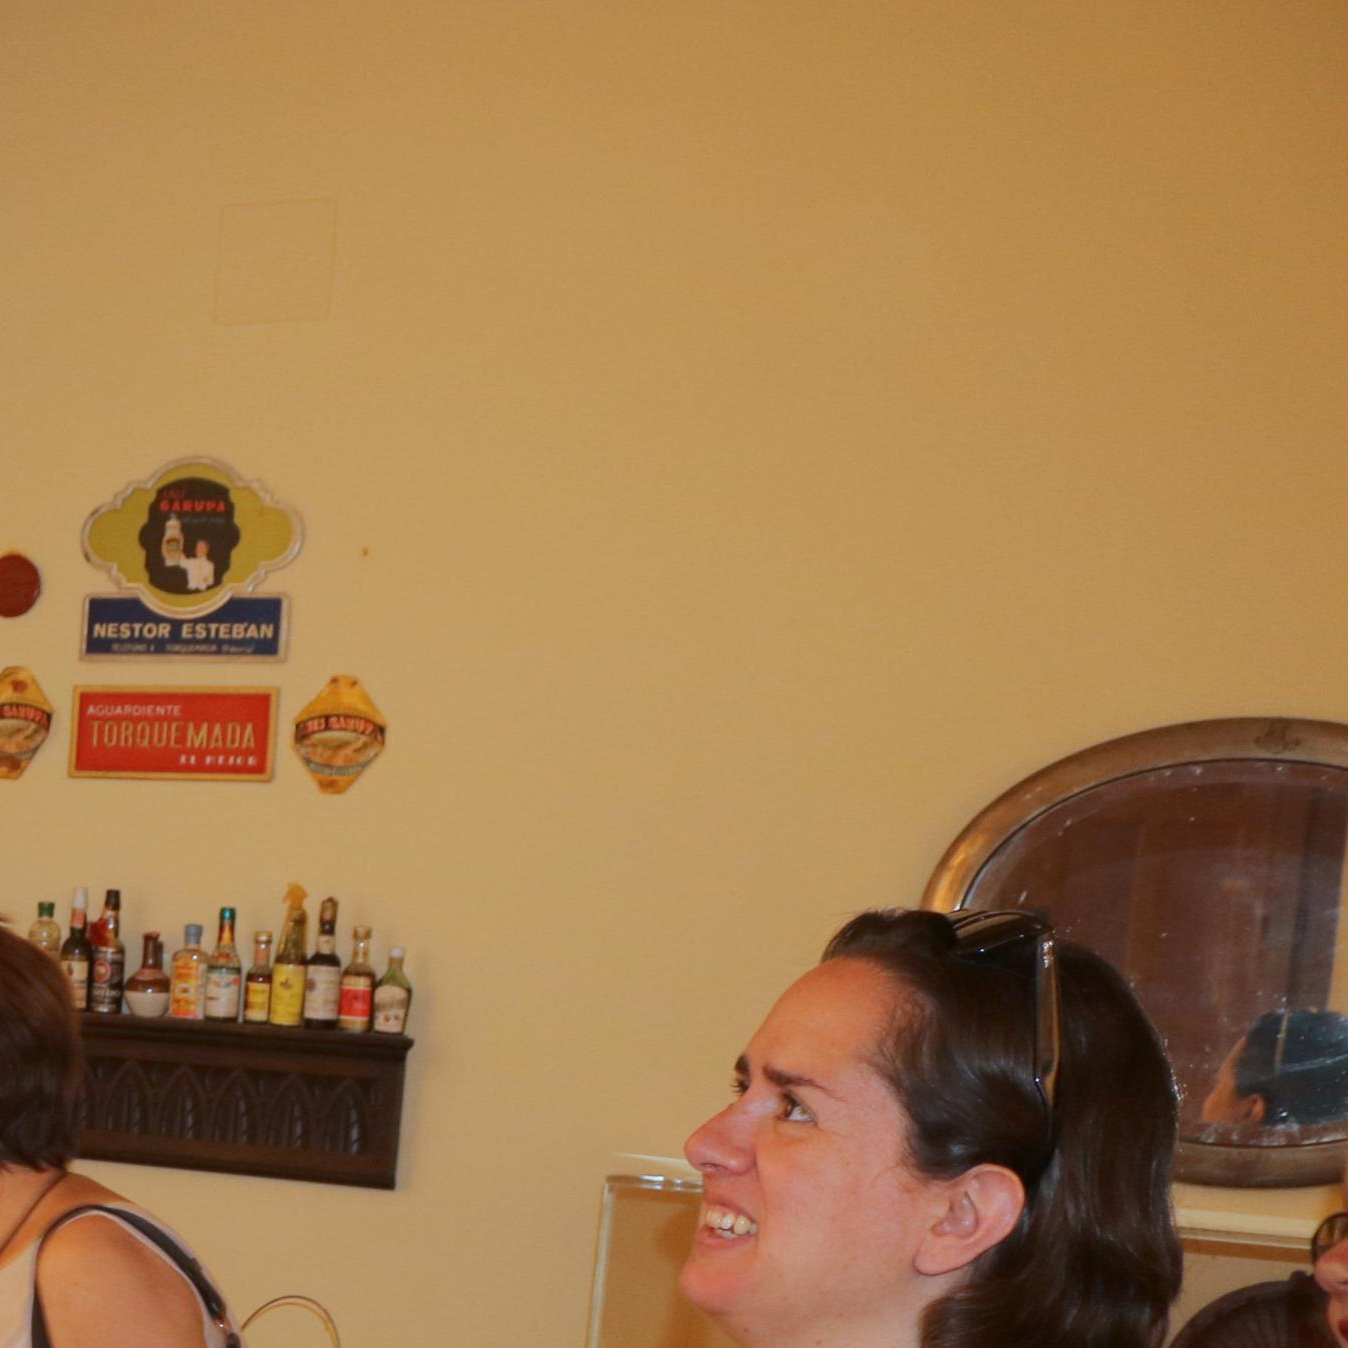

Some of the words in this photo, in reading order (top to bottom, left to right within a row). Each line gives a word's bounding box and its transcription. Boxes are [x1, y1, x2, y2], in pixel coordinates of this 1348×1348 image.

[93, 622, 171, 638] NESTOR
[87, 705, 182, 716] AGUARDIENTE
[89, 720, 255, 749] TORQUEMADA
